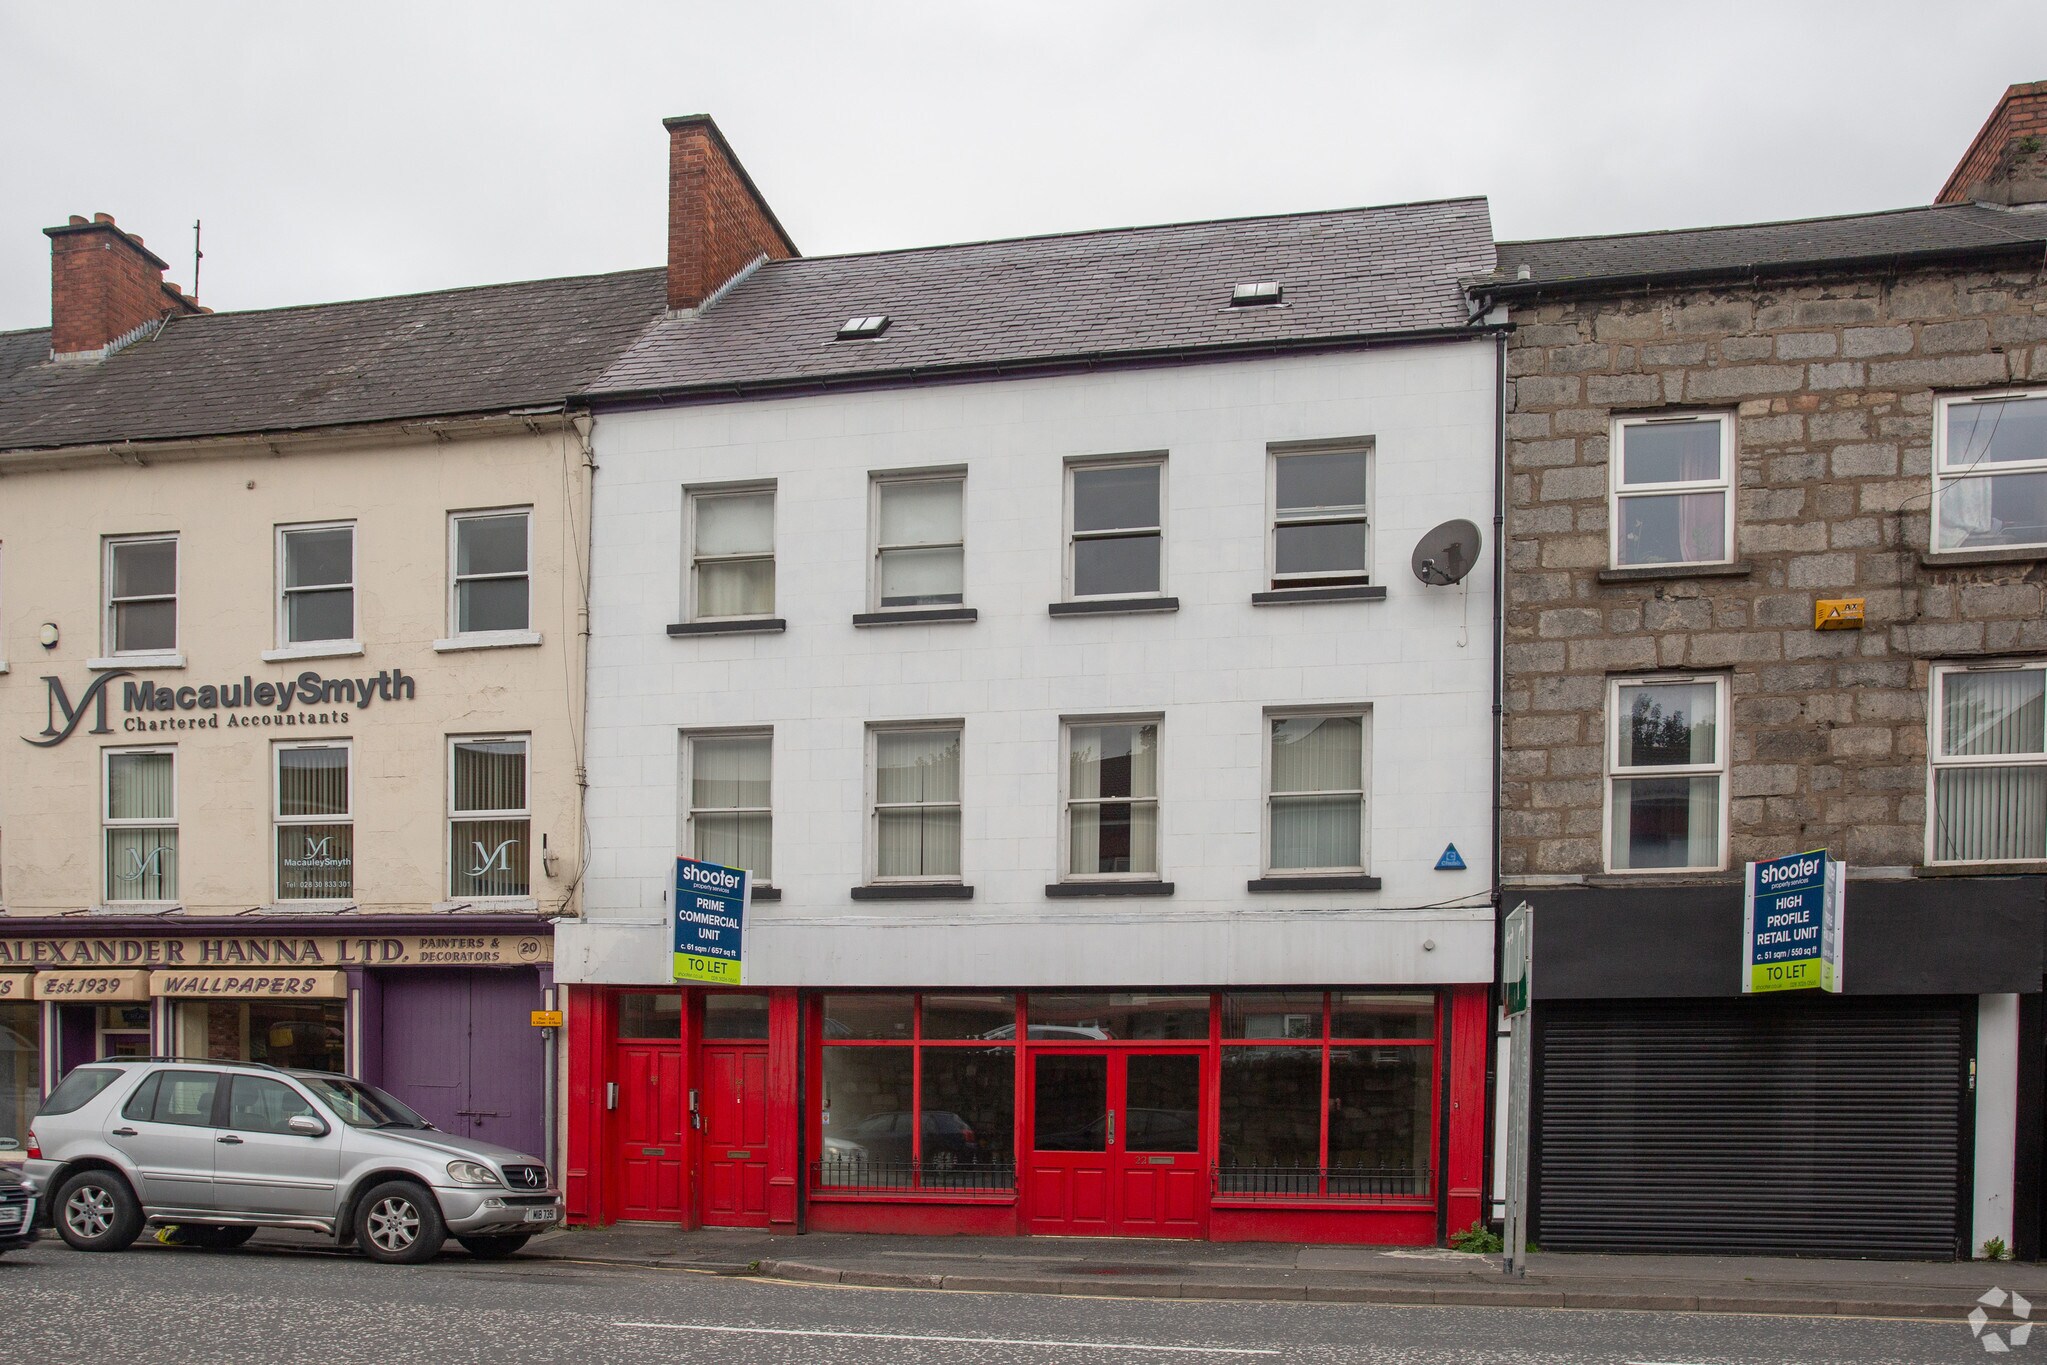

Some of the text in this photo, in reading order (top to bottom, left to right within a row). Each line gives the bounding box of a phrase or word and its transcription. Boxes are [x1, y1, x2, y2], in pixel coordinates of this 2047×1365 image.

[123, 668, 416, 712] MacauleySmyth
[123, 709, 350, 732] Chartered Accountants
[284, 858, 352, 867] MacauleySmyth
[683, 863, 740, 889] shooter
[1760, 858, 1820, 884] shooter
[338, 880, 351, 888] 301
[693, 882, 730, 894] property services
[1771, 877, 1809, 890] property services
[696, 897, 725, 912] PRIME
[1776, 894, 1803, 910] HIGH
[679, 909, 740, 930] COMMERCIAL
[1767, 910, 1810, 928] PROFILE
[698, 928, 721, 941] UNIT
[1757, 926, 1819, 945] RETAIL UNIT
[0, 937, 410, 965] ALEXANDER HANNA LTD.
[419, 937, 500, 950] PAINTERS &
[520, 942, 538, 955] 20
[686, 943, 694, 951] 61
[694, 945, 707, 954] sqm
[711, 946, 723, 955] 657
[723, 949, 730, 957] sq
[731, 949, 737, 957] ft
[419, 951, 500, 963] DECORATORS
[1764, 950, 1772, 960] 51
[1773, 949, 1787, 960] sqm
[1791, 947, 1803, 957] 550
[1803, 947, 1812, 956] sq
[1812, 945, 1818, 954] ft
[688, 957, 728, 975] TO LET
[1767, 964, 1807, 981] TO LET
[44, 977, 121, 995] Est.1939
[164, 976, 317, 995] WALLPAPERS
